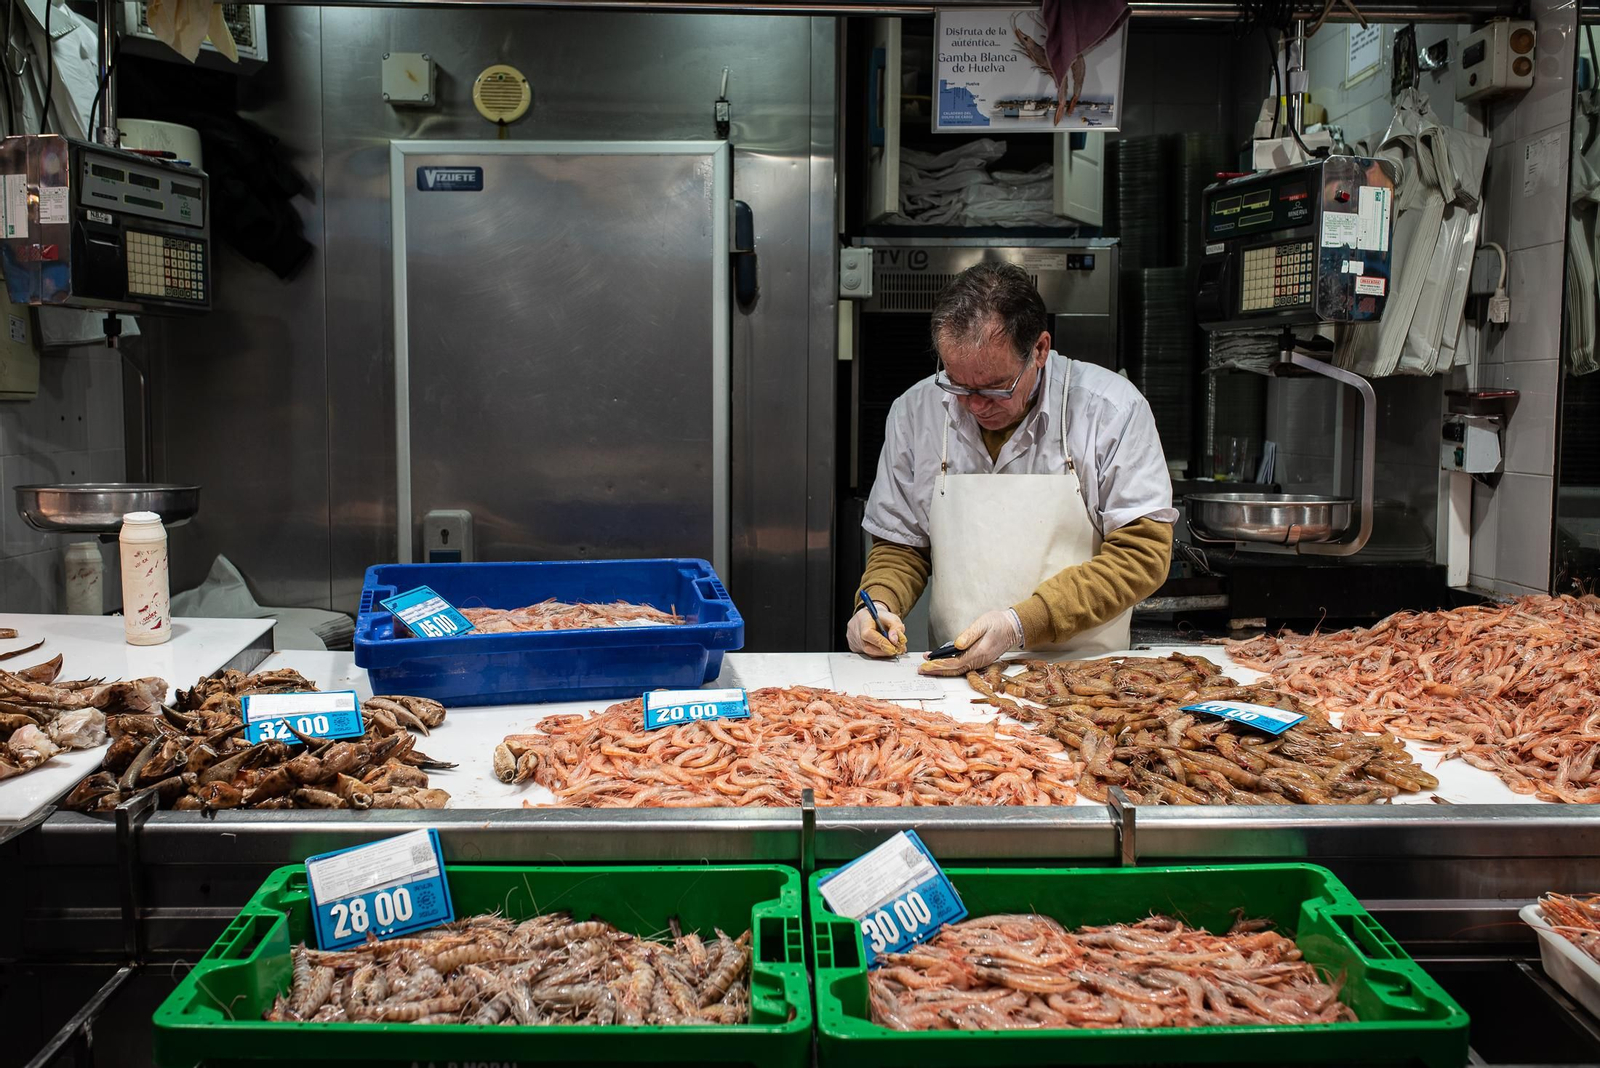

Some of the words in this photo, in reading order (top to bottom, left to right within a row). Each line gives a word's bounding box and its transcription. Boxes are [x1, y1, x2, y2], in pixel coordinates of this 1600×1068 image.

[945, 27, 983, 37] Disfruta
[985, 27, 997, 36] de
[998, 27, 1007, 36] la
[938, 52, 977, 63] Gamba
[980, 52, 1018, 62] Blanca
[952, 63, 966, 73] de
[968, 63, 1006, 73] Huelva
[424, 169, 476, 188] VIZUETE
[1287, 208, 1308, 218] MINERVA
[873, 249, 900, 265] TV
[432, 613, 458, 633] 00
[656, 706, 684, 723] 20
[689, 703, 718, 719] 00
[258, 719, 292, 741] 32
[297, 715, 330, 736] 00
[330, 897, 370, 940] 28
[374, 887, 413, 926] 00
[861, 910, 900, 953] 30
[893, 891, 932, 934] 00
